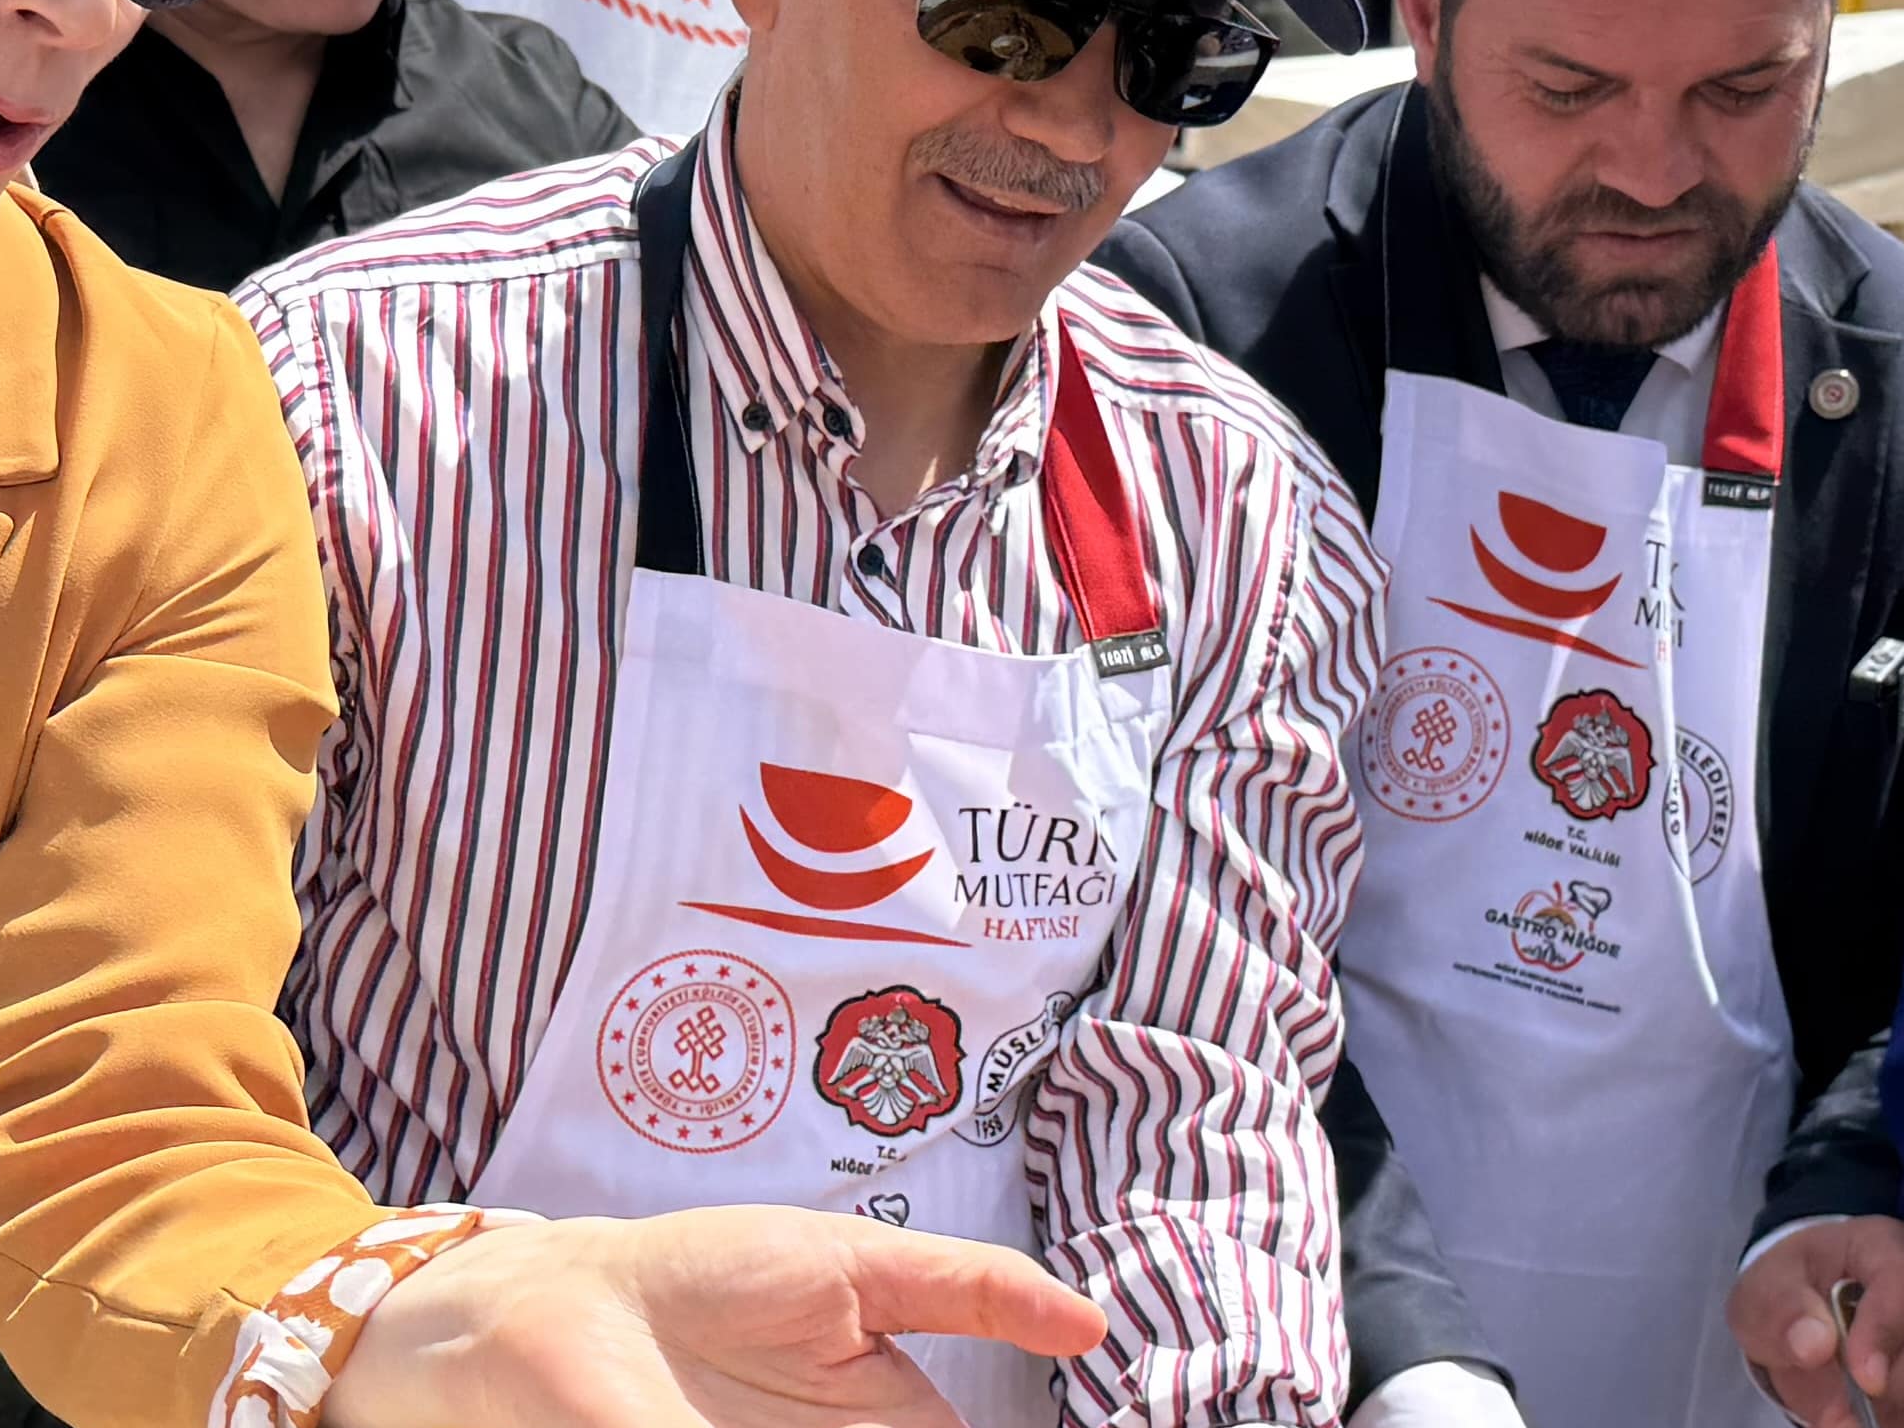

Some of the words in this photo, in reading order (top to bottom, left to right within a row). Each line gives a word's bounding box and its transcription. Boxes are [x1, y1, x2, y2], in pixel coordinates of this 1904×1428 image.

[1676, 736, 1729, 848] ELEDİYESİ
[954, 871, 1117, 909] MUTFAĞI
[983, 915, 1080, 941] HAFTASI
[1484, 908, 1558, 940] GASTRO
